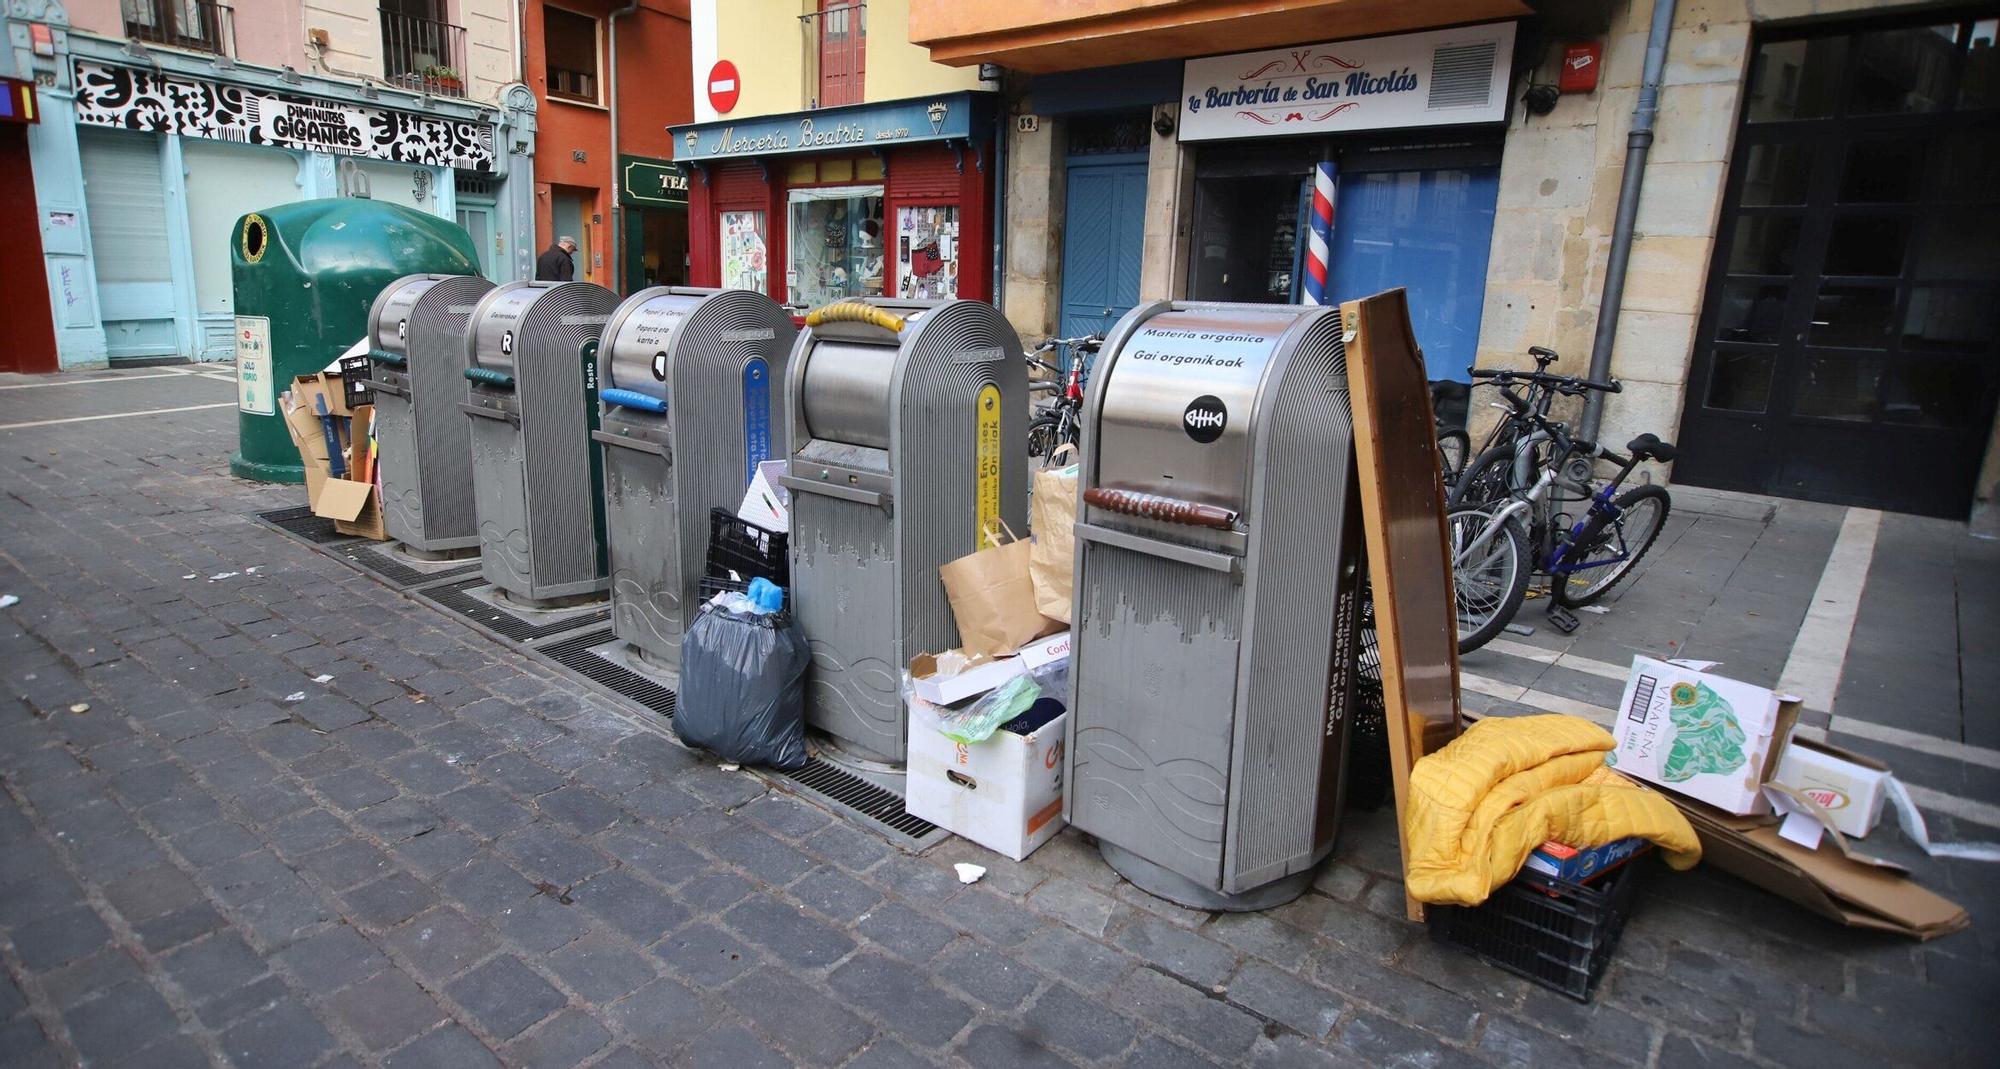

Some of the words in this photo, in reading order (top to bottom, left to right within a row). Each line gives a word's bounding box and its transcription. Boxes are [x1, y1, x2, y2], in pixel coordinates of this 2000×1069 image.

[1188, 95, 1201, 114] La
[1205, 81, 1279, 109] Barbería
[1283, 86, 1298, 101] de
[1302, 77, 1338, 101] San
[1345, 67, 1418, 98] Nicolás
[711, 127, 789, 154] Mercería
[798, 117, 865, 147] Beatriz
[875, 130, 894, 140] desde
[502, 333, 512, 352] R
[1143, 328, 1197, 339] Materia
[1200, 332, 1266, 344] orgánica
[586, 362, 595, 389] Resto
[1133, 350, 1159, 362] Gai
[1160, 354, 1245, 368] organikoak
[981, 421, 989, 479] Envases
[990, 420, 998, 476] Ontziak
[1326, 672, 1339, 736] Materia
[1335, 593, 1347, 668] orgánica
[1335, 691, 1344, 720] Gai
[1341, 591, 1353, 686] organikoak
